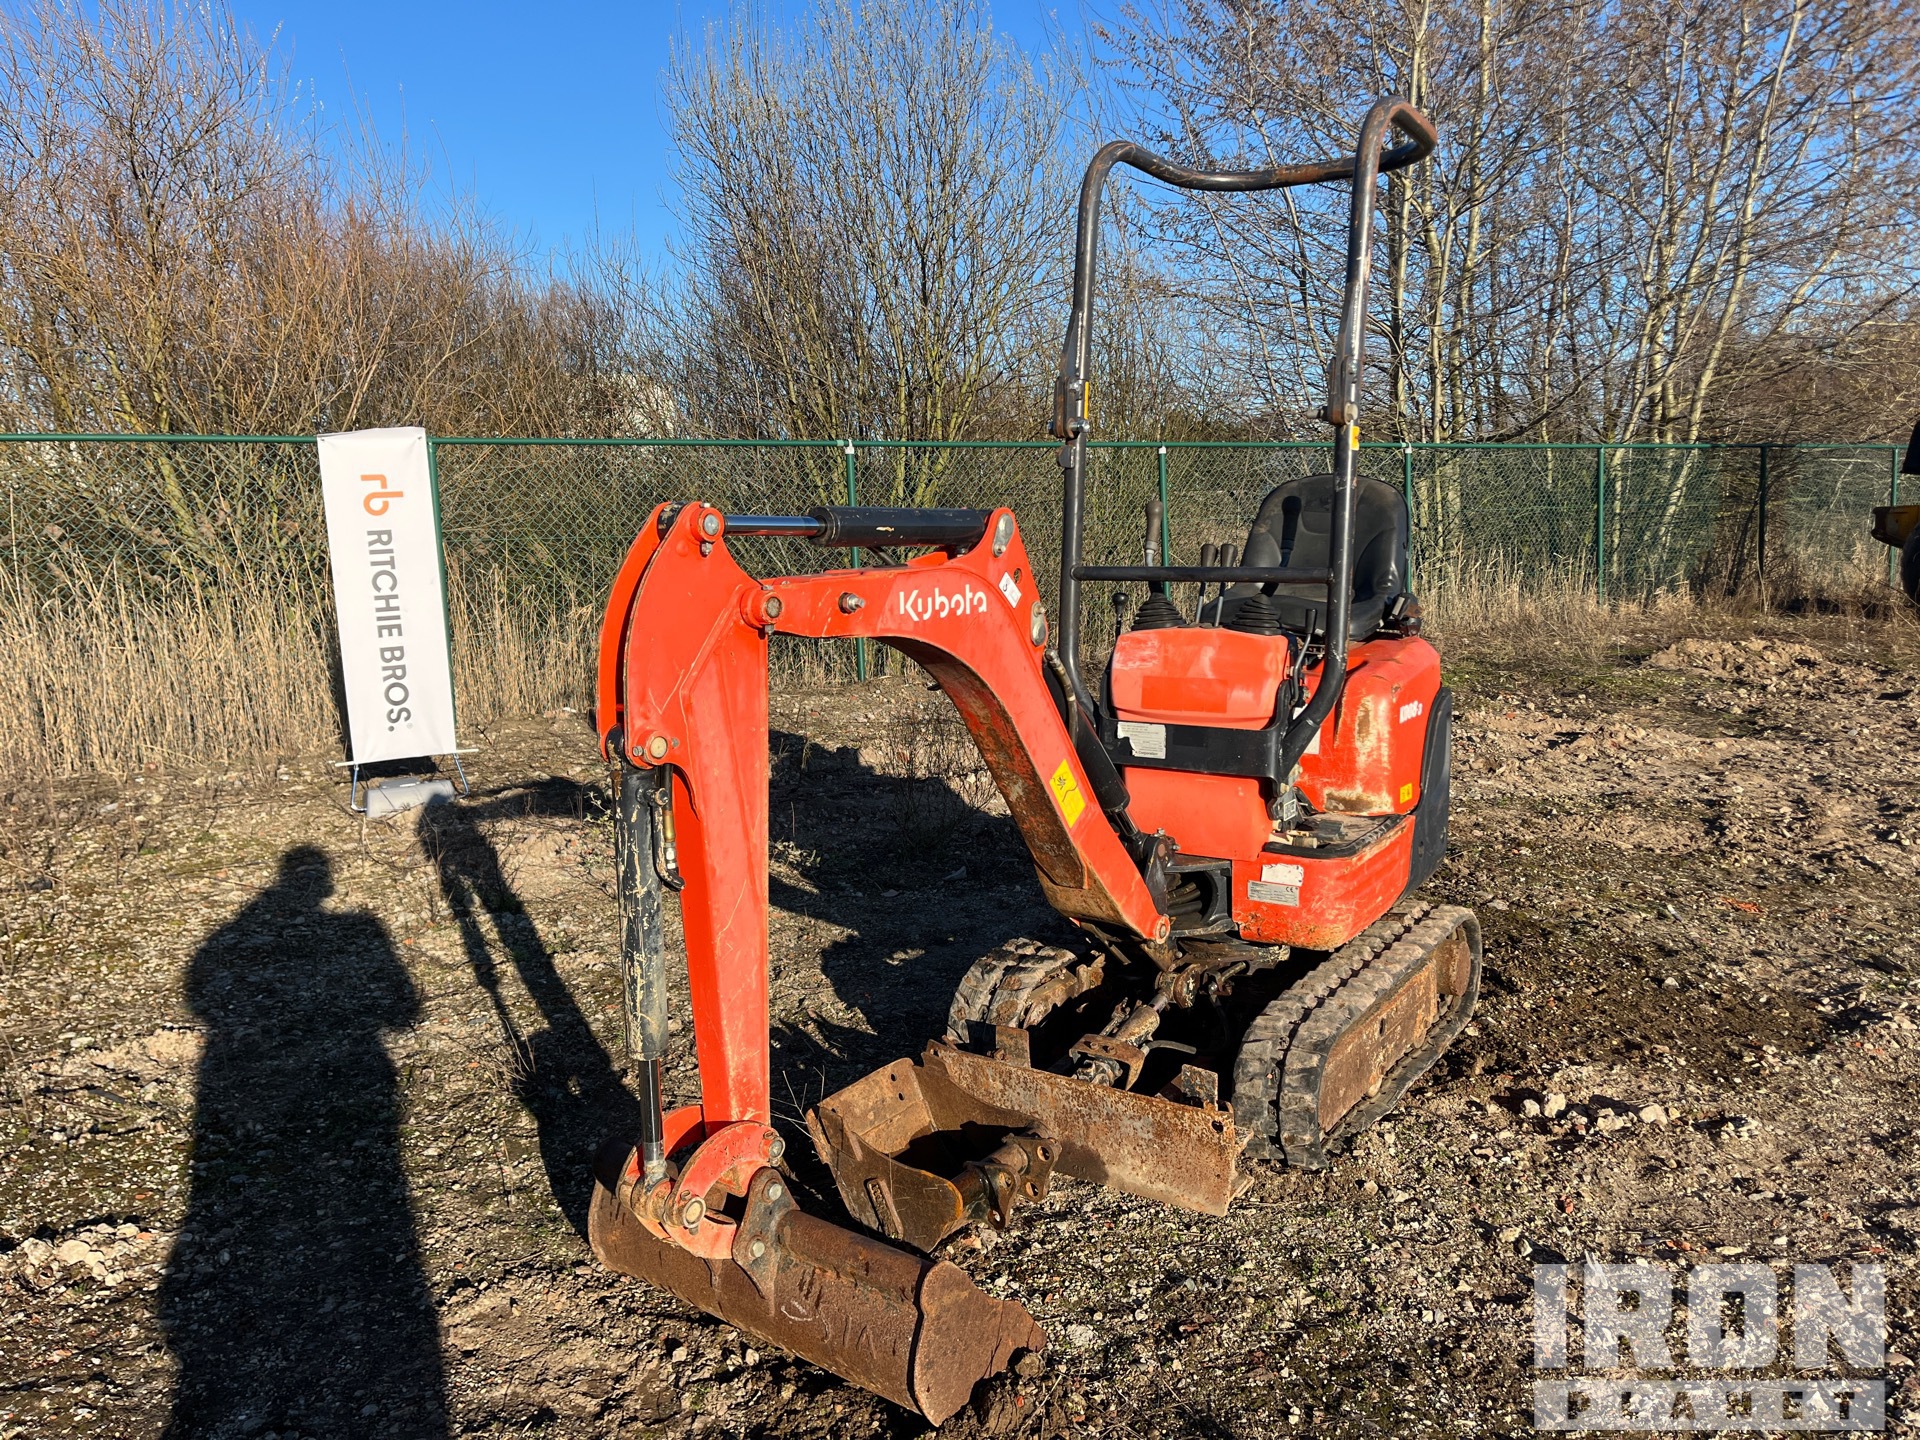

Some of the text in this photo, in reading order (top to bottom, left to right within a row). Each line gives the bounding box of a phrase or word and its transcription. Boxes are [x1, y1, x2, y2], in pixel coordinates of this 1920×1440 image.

[360, 473, 404, 516] rb
[899, 584, 987, 621] Kubota
[366, 529, 412, 732] RITCHIE BROS.
